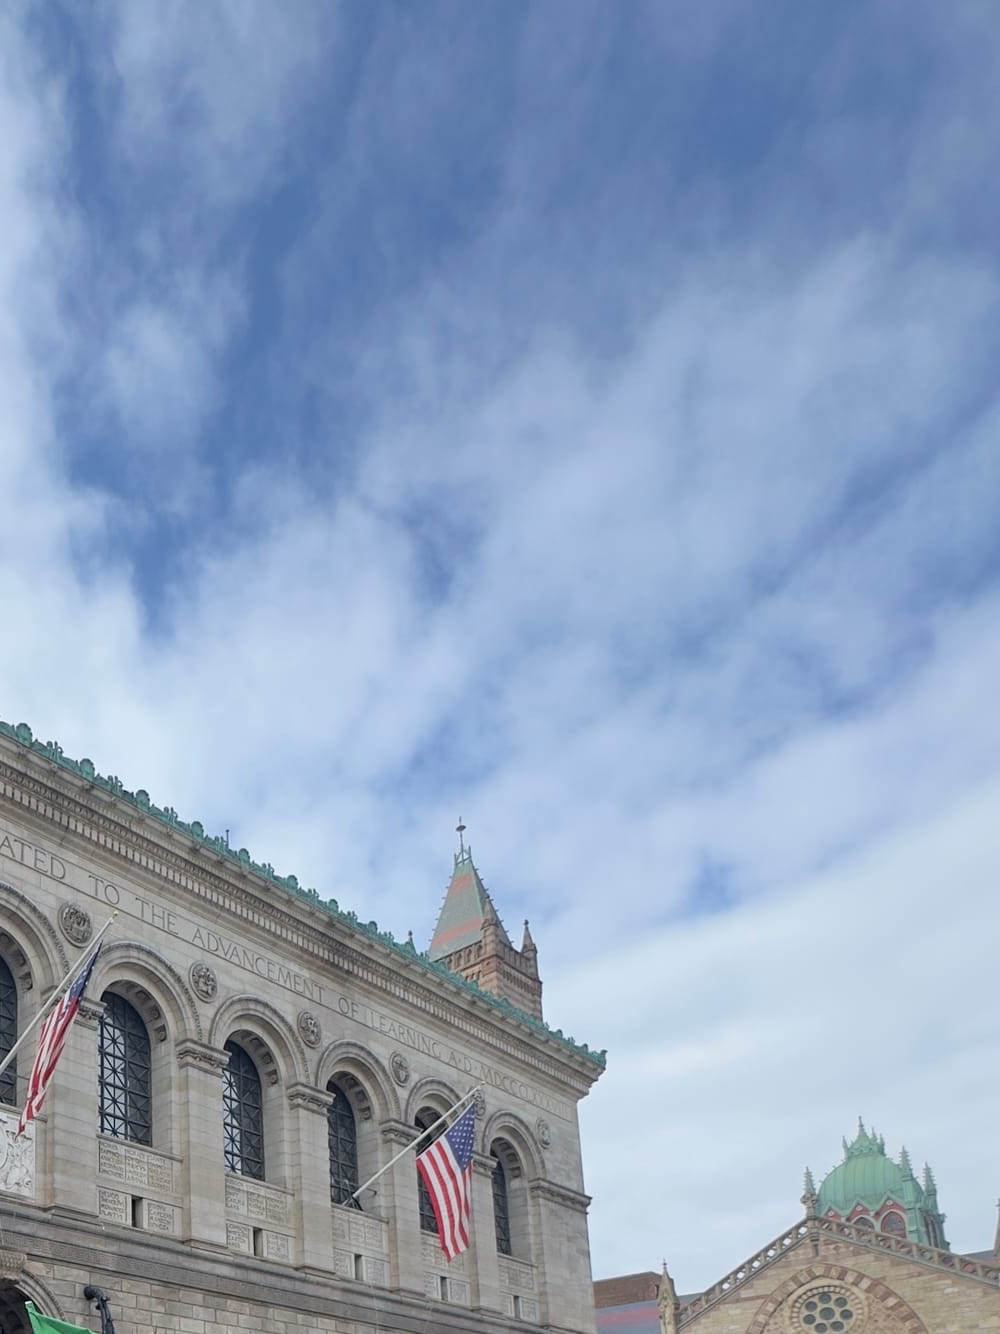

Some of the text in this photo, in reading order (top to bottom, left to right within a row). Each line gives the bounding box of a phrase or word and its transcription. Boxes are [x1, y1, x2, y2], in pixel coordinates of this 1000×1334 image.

[88, 875, 120, 905] TO
[135, 897, 179, 936] THE
[192, 927, 325, 1004] ADVANCEMENT
[338, 997, 359, 1017] OF
[370, 1011, 443, 1058] LEARNING
